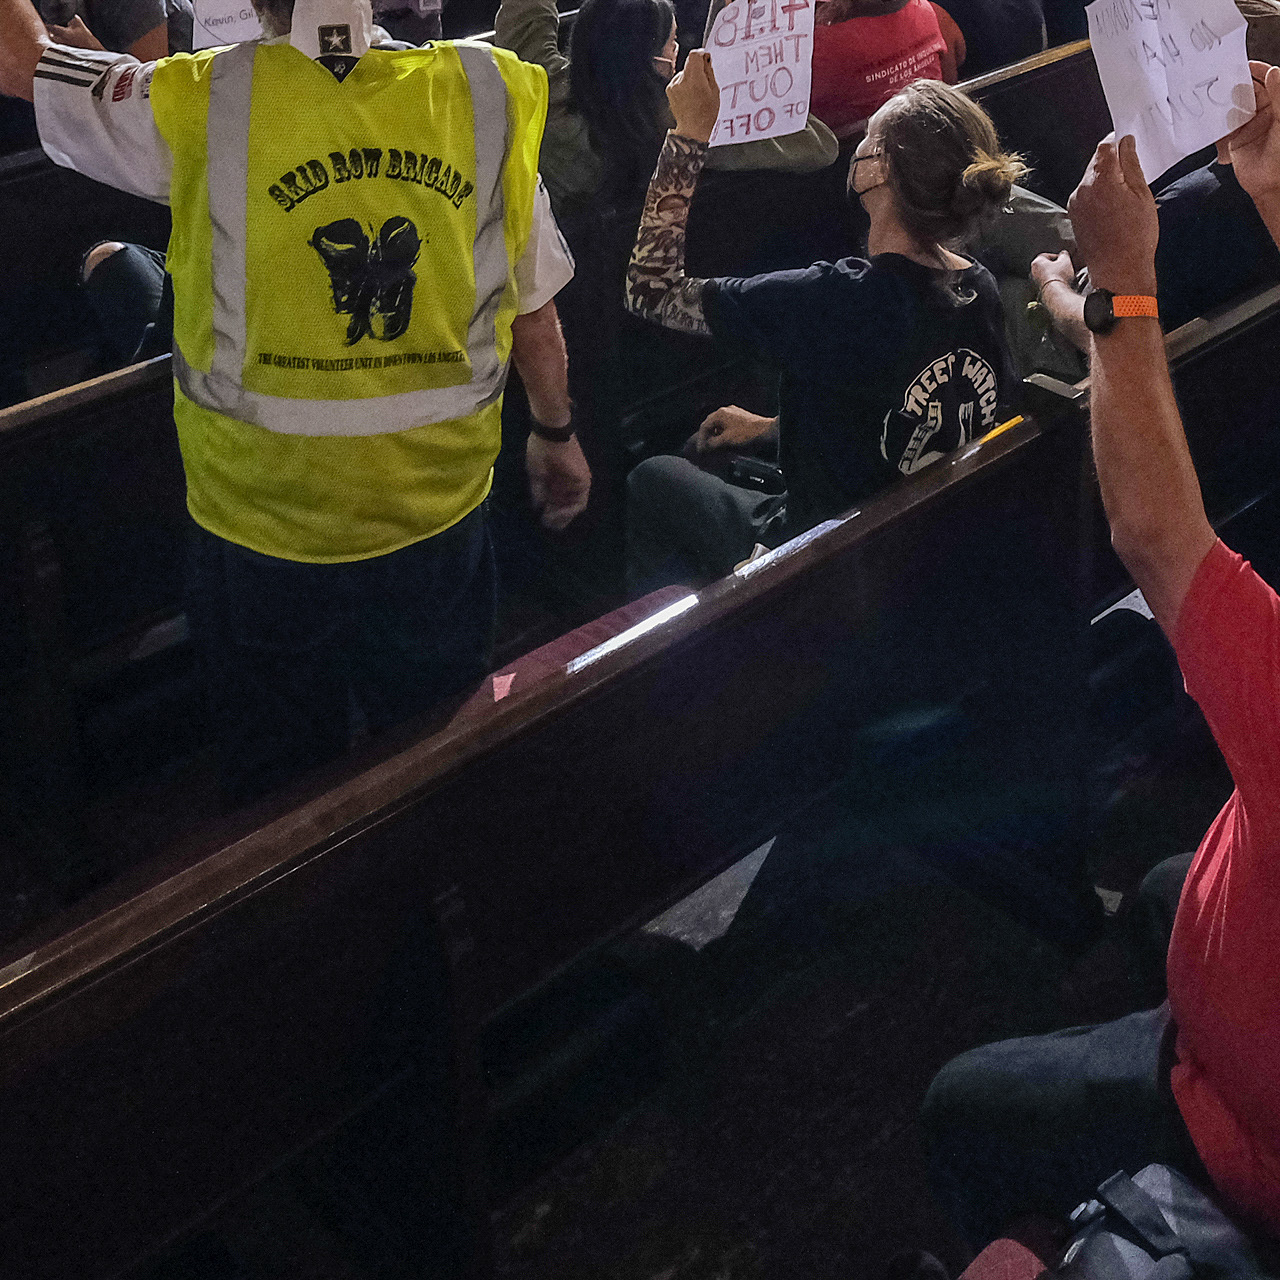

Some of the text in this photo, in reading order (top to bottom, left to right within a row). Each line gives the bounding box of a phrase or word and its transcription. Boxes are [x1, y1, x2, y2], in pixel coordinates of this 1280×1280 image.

[865, 61, 908, 83] SINDICATO
[268, 148, 474, 213] SKID ROW BRIGADE
[962, 356, 997, 426] WATCH
